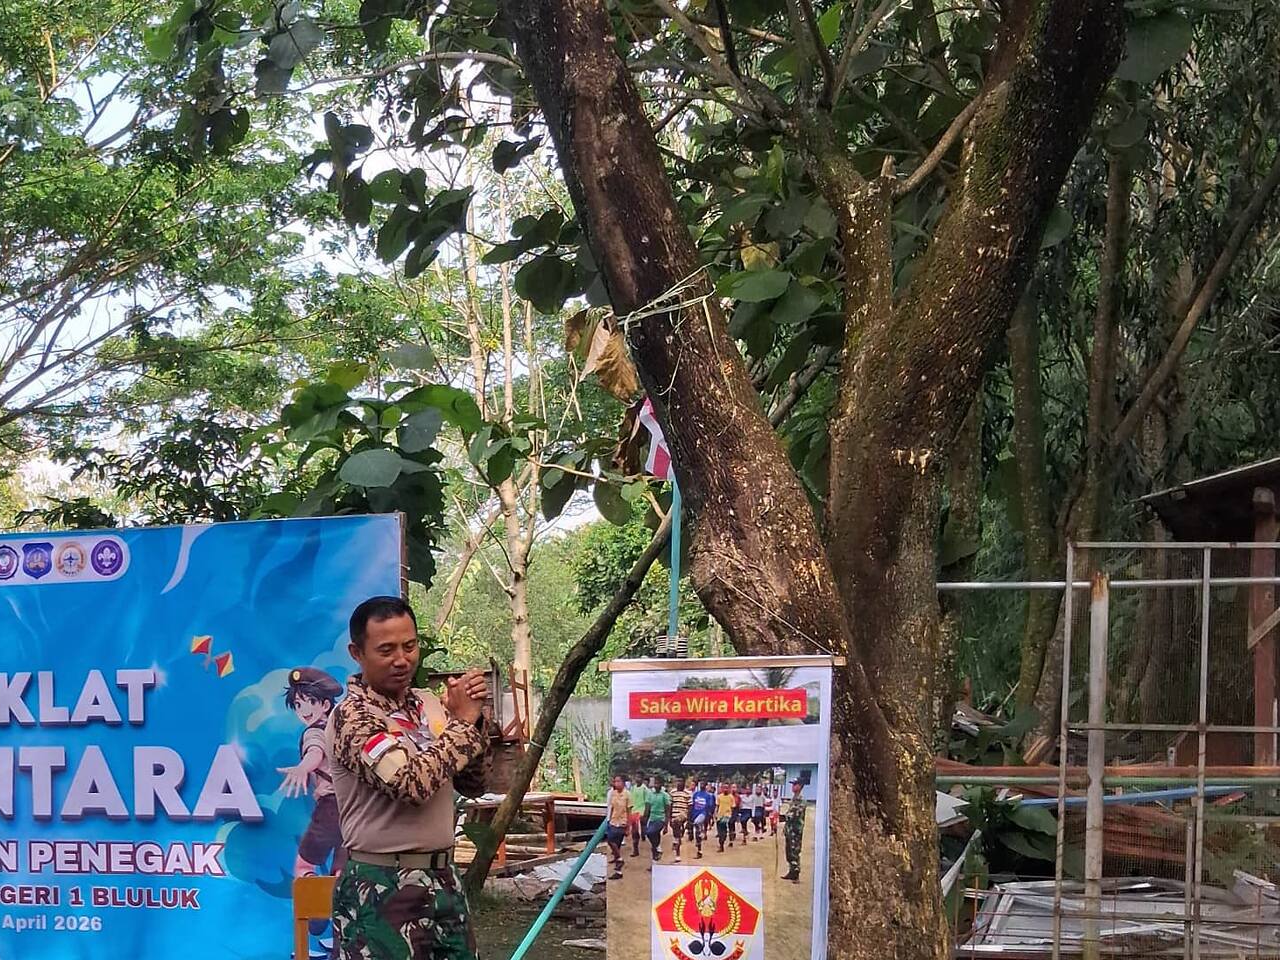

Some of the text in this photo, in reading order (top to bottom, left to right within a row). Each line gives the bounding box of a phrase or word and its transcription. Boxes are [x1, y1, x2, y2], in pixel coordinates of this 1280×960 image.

[640, 696, 802, 713] Saka Wira kartika
[29, 839, 226, 877] PENEGAK
[69, 885, 84, 907] 1
[92, 886, 200, 910] BLULUK
[2, 913, 47, 933] April
[54, 915, 103, 932] 2026
